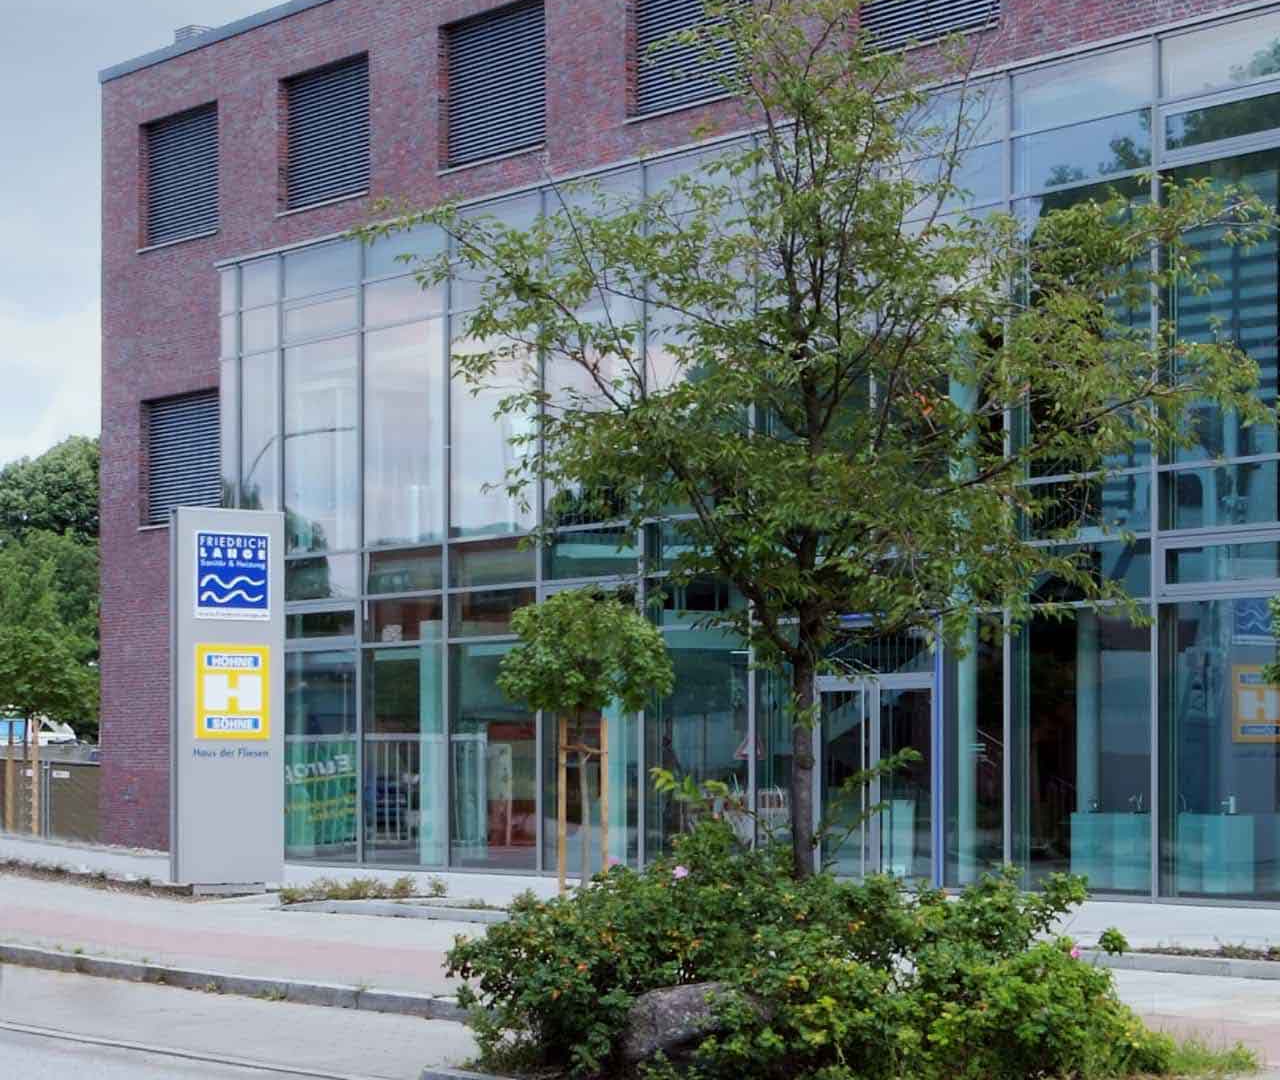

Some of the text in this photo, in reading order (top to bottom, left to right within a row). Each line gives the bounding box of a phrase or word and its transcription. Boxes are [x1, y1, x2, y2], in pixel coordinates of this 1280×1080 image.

[199, 535, 267, 549] FRIEDRICH
[199, 546, 267, 561] LANGE
[204, 674, 261, 710] H
[193, 747, 269, 758] Haus der Fliesen
